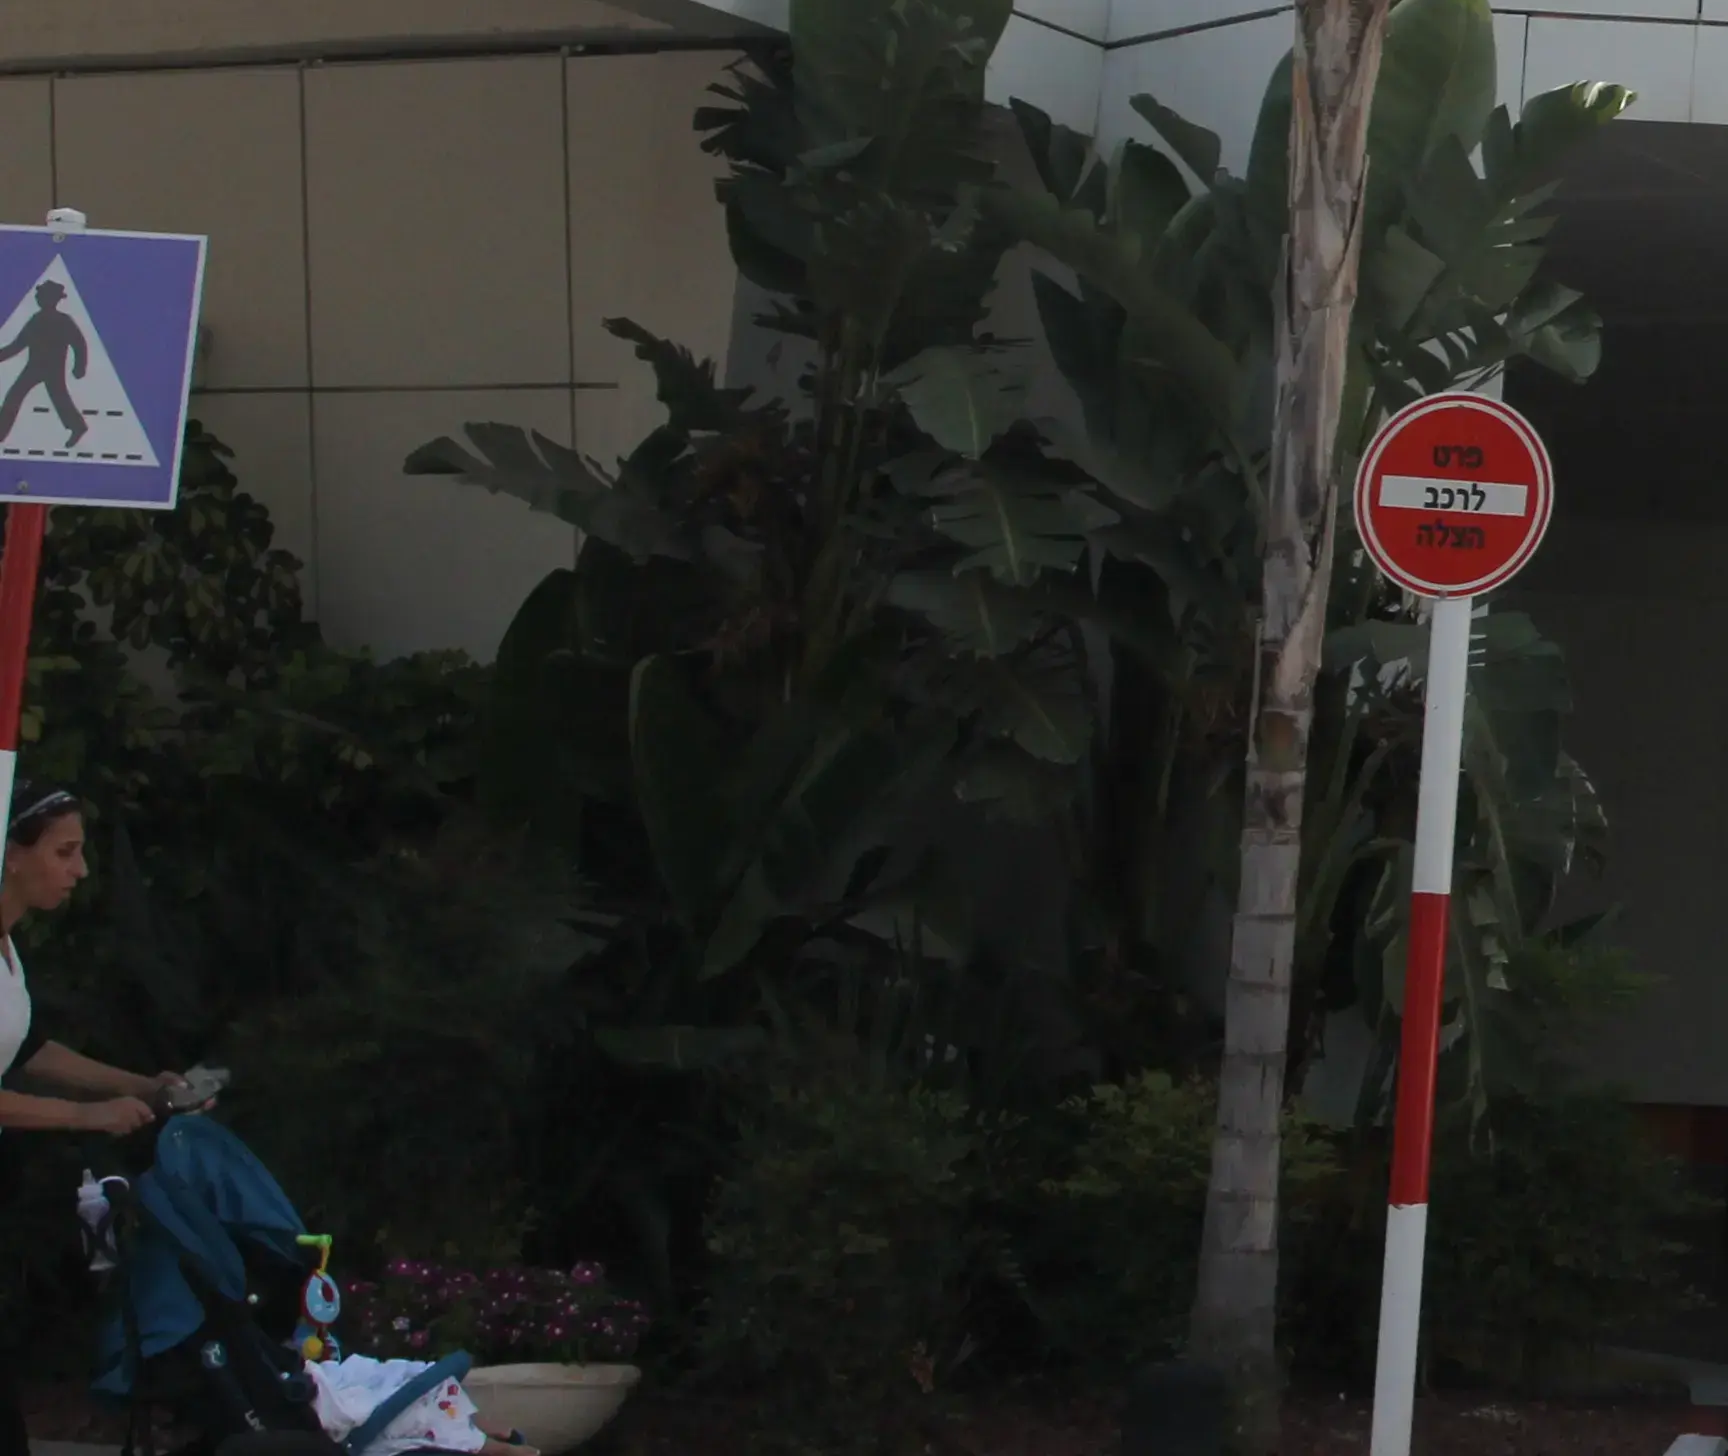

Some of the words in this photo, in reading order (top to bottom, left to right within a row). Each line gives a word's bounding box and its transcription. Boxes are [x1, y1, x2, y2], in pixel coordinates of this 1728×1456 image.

[1432, 444, 1484, 469] פרט
[1423, 483, 1487, 512] לרכב
[1415, 518, 1486, 549] הצלה
